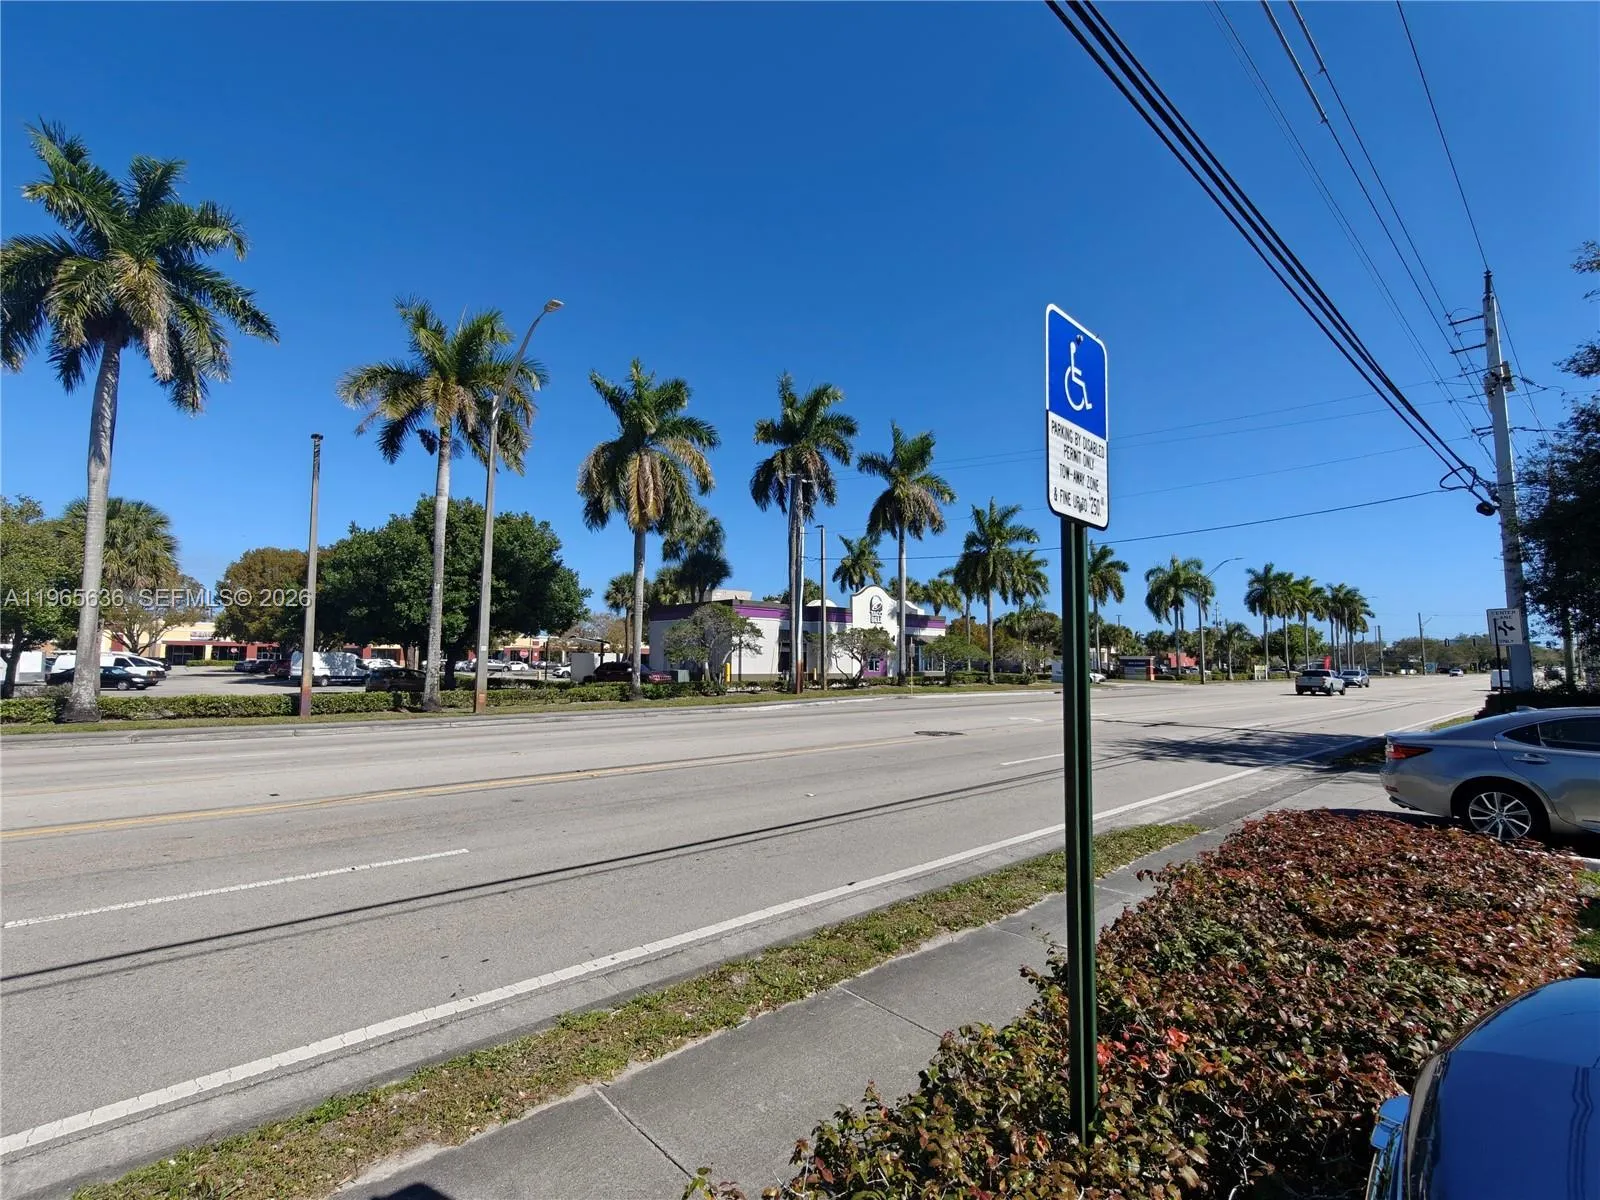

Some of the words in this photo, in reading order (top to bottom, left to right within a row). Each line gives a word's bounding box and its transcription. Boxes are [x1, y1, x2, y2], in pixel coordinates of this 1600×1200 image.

[1051, 419, 1073, 443] PARKING
[1074, 432, 1081, 447] BY
[1082, 436, 1104, 459] DISABLED
[1063, 443, 1081, 464] PERMIT
[1082, 453, 1095, 470] ONLY
[1059, 463, 1085, 486] TOW-AWAY
[1086, 474, 1099, 493] ZONE
[1053, 486, 1058, 502] &
[1059, 489, 1071, 506] FINE
